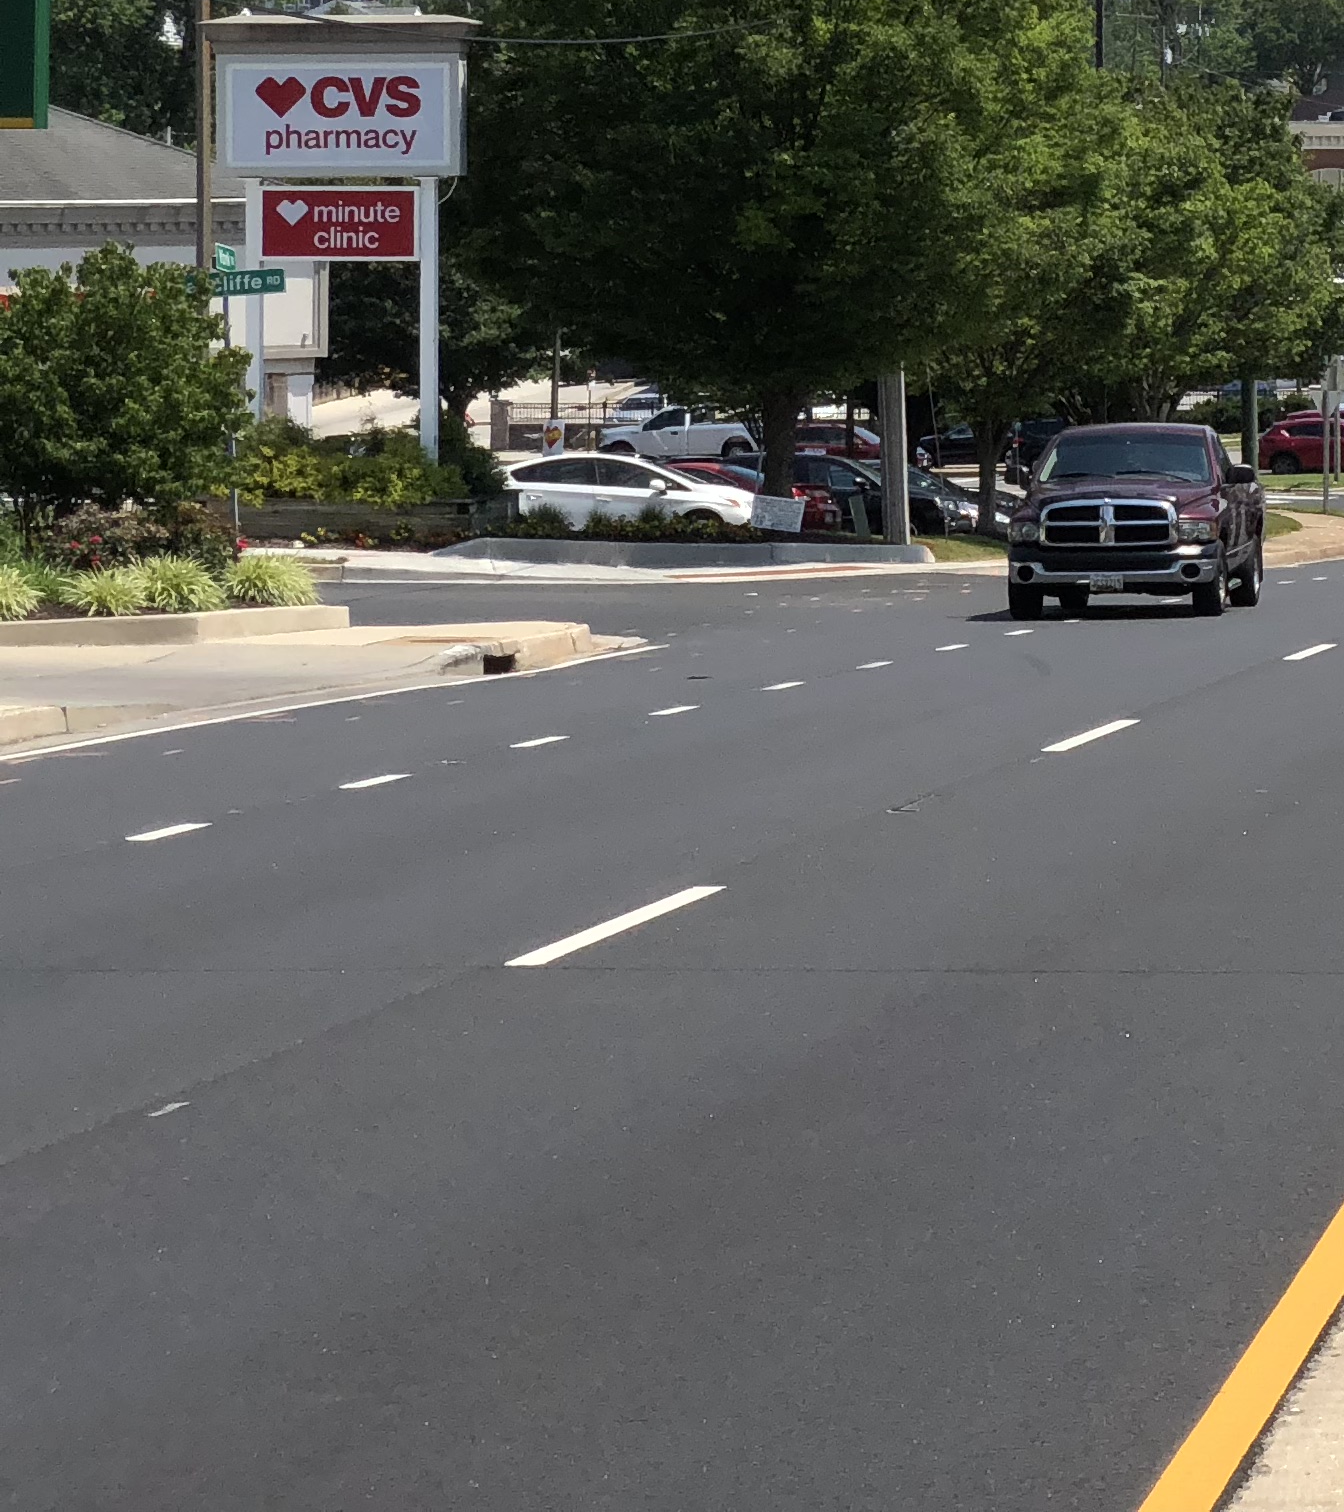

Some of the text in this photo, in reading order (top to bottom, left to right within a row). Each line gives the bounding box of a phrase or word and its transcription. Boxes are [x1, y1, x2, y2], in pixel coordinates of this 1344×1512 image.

[310, 76, 422, 118] CVS
[264, 123, 417, 155] pharmacy
[313, 200, 401, 223] minute
[313, 226, 380, 249] clinic
[266, 275, 281, 286] RD
